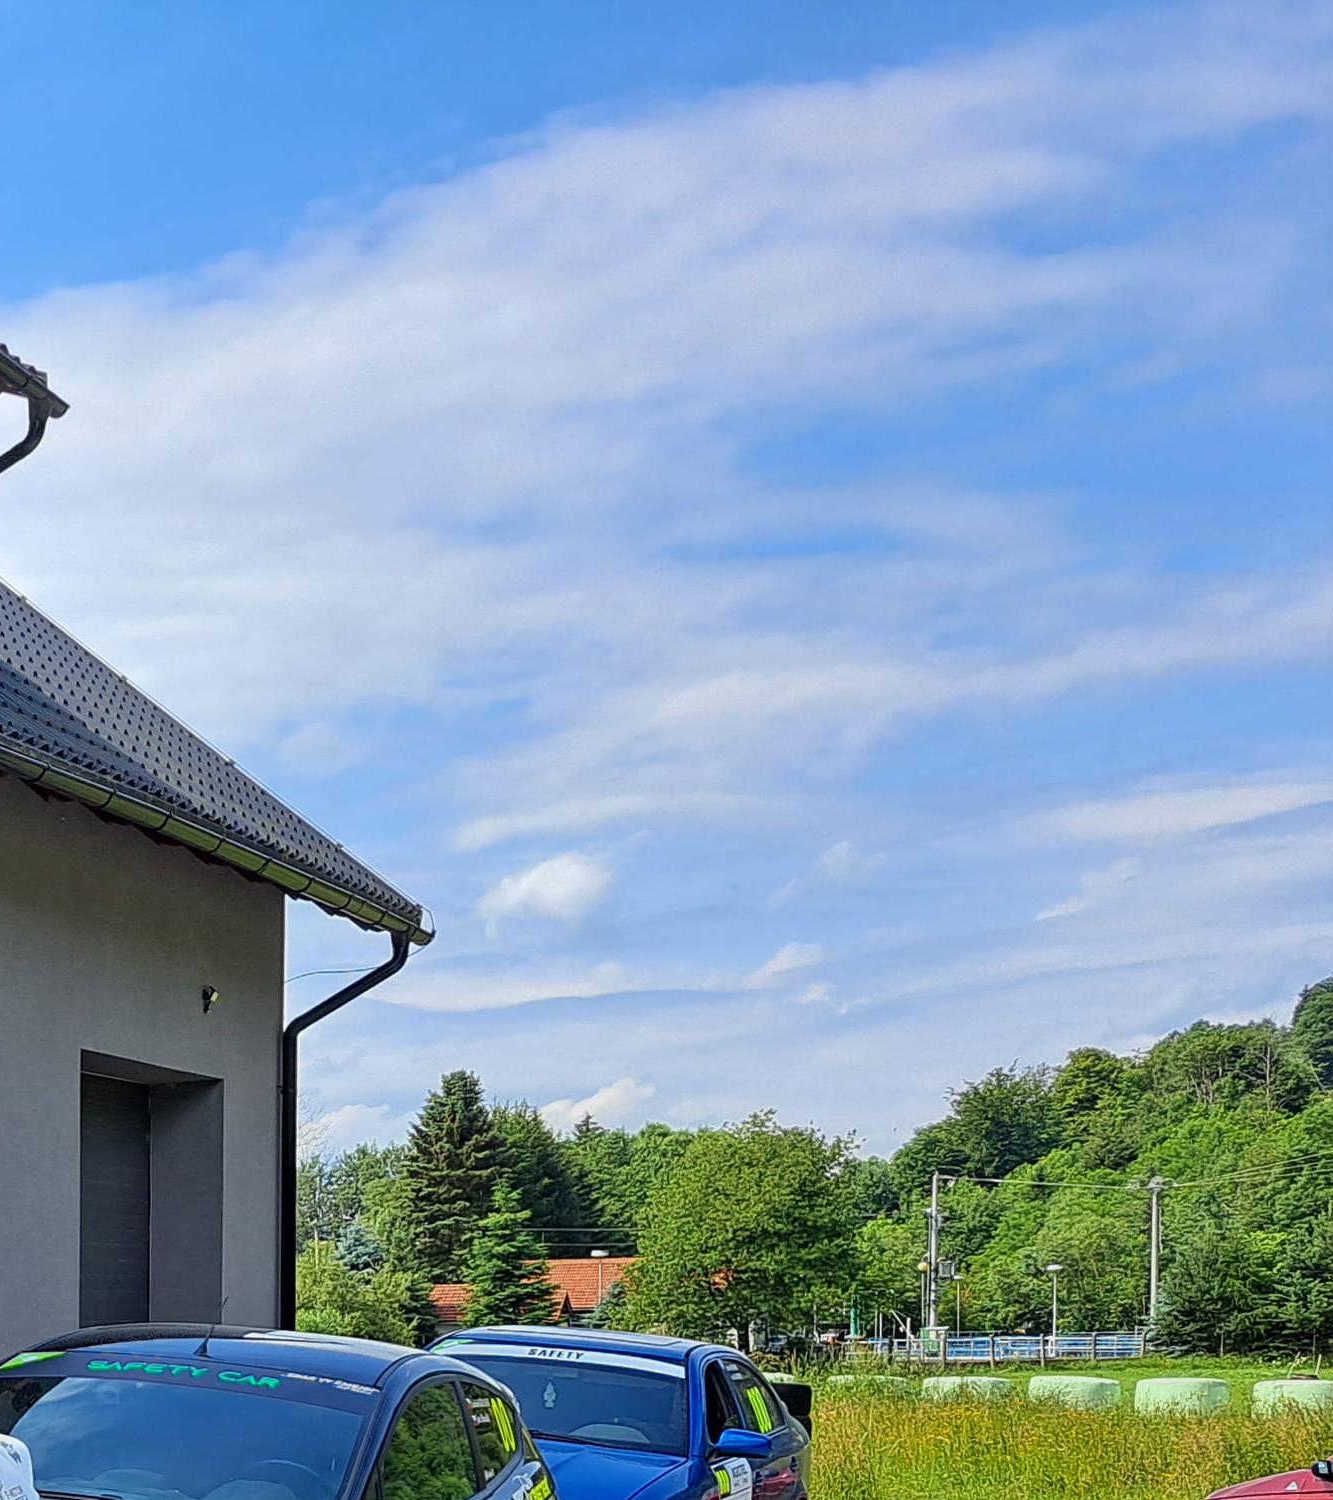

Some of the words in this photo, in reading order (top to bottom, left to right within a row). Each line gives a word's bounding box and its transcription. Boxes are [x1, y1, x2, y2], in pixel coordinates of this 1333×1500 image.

[528, 1348, 584, 1360] SAFETY
[87, 1360, 210, 1377] SAFETY
[218, 1371, 280, 1389] CAR
